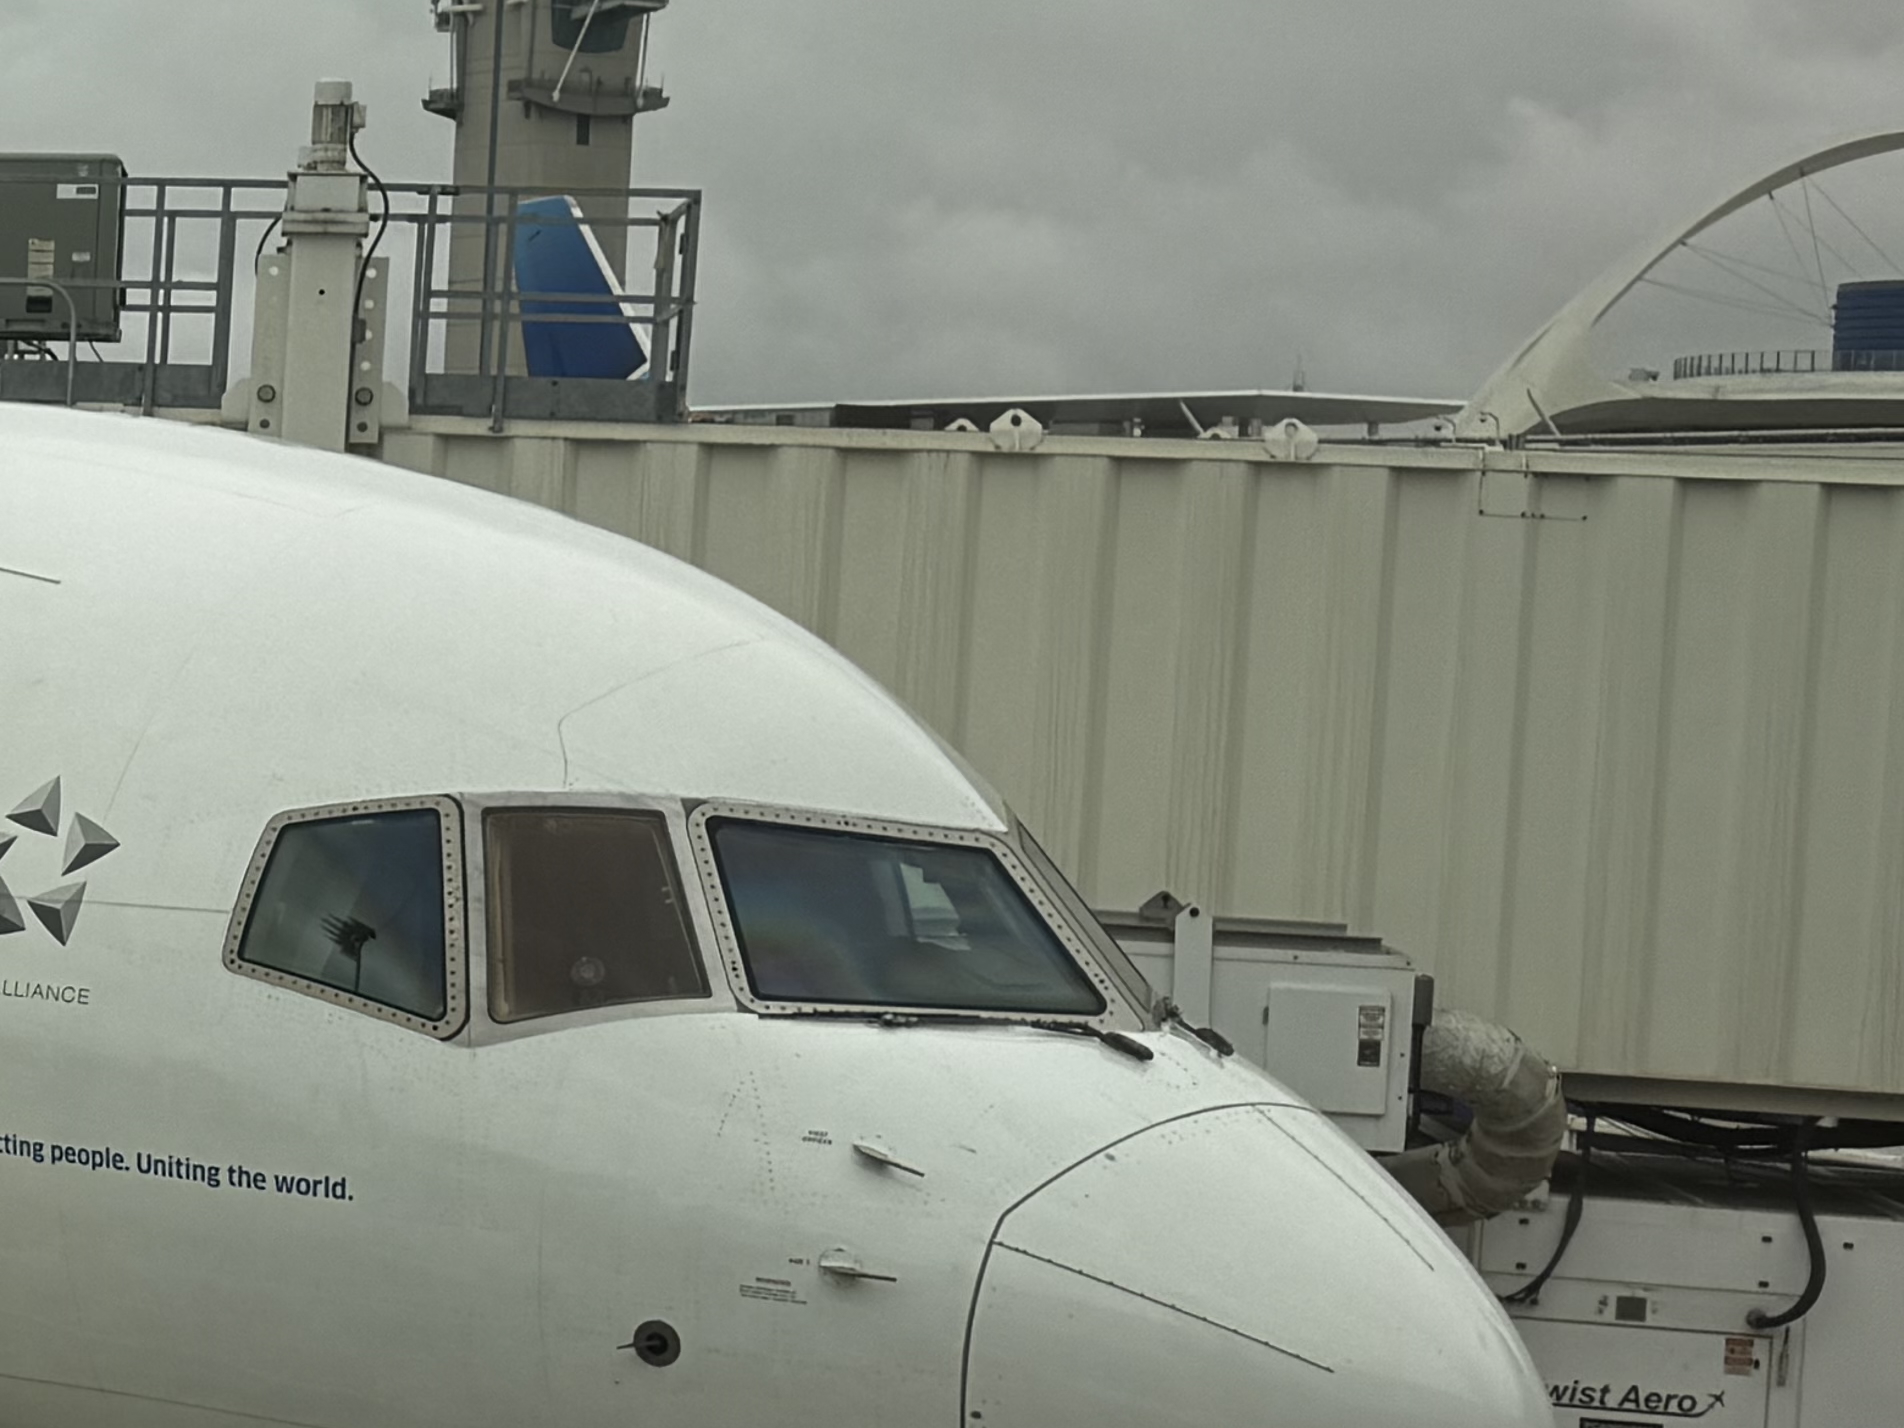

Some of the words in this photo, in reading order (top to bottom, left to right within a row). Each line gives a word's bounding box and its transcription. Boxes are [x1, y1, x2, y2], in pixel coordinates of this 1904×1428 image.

[50, 1141, 131, 1175] people.
[136, 1152, 221, 1188] Uniting
[227, 1163, 267, 1192] the
[274, 1171, 355, 1202] world.
[1545, 1380, 1611, 1407] wist
[1618, 1385, 1698, 1414] Aero
